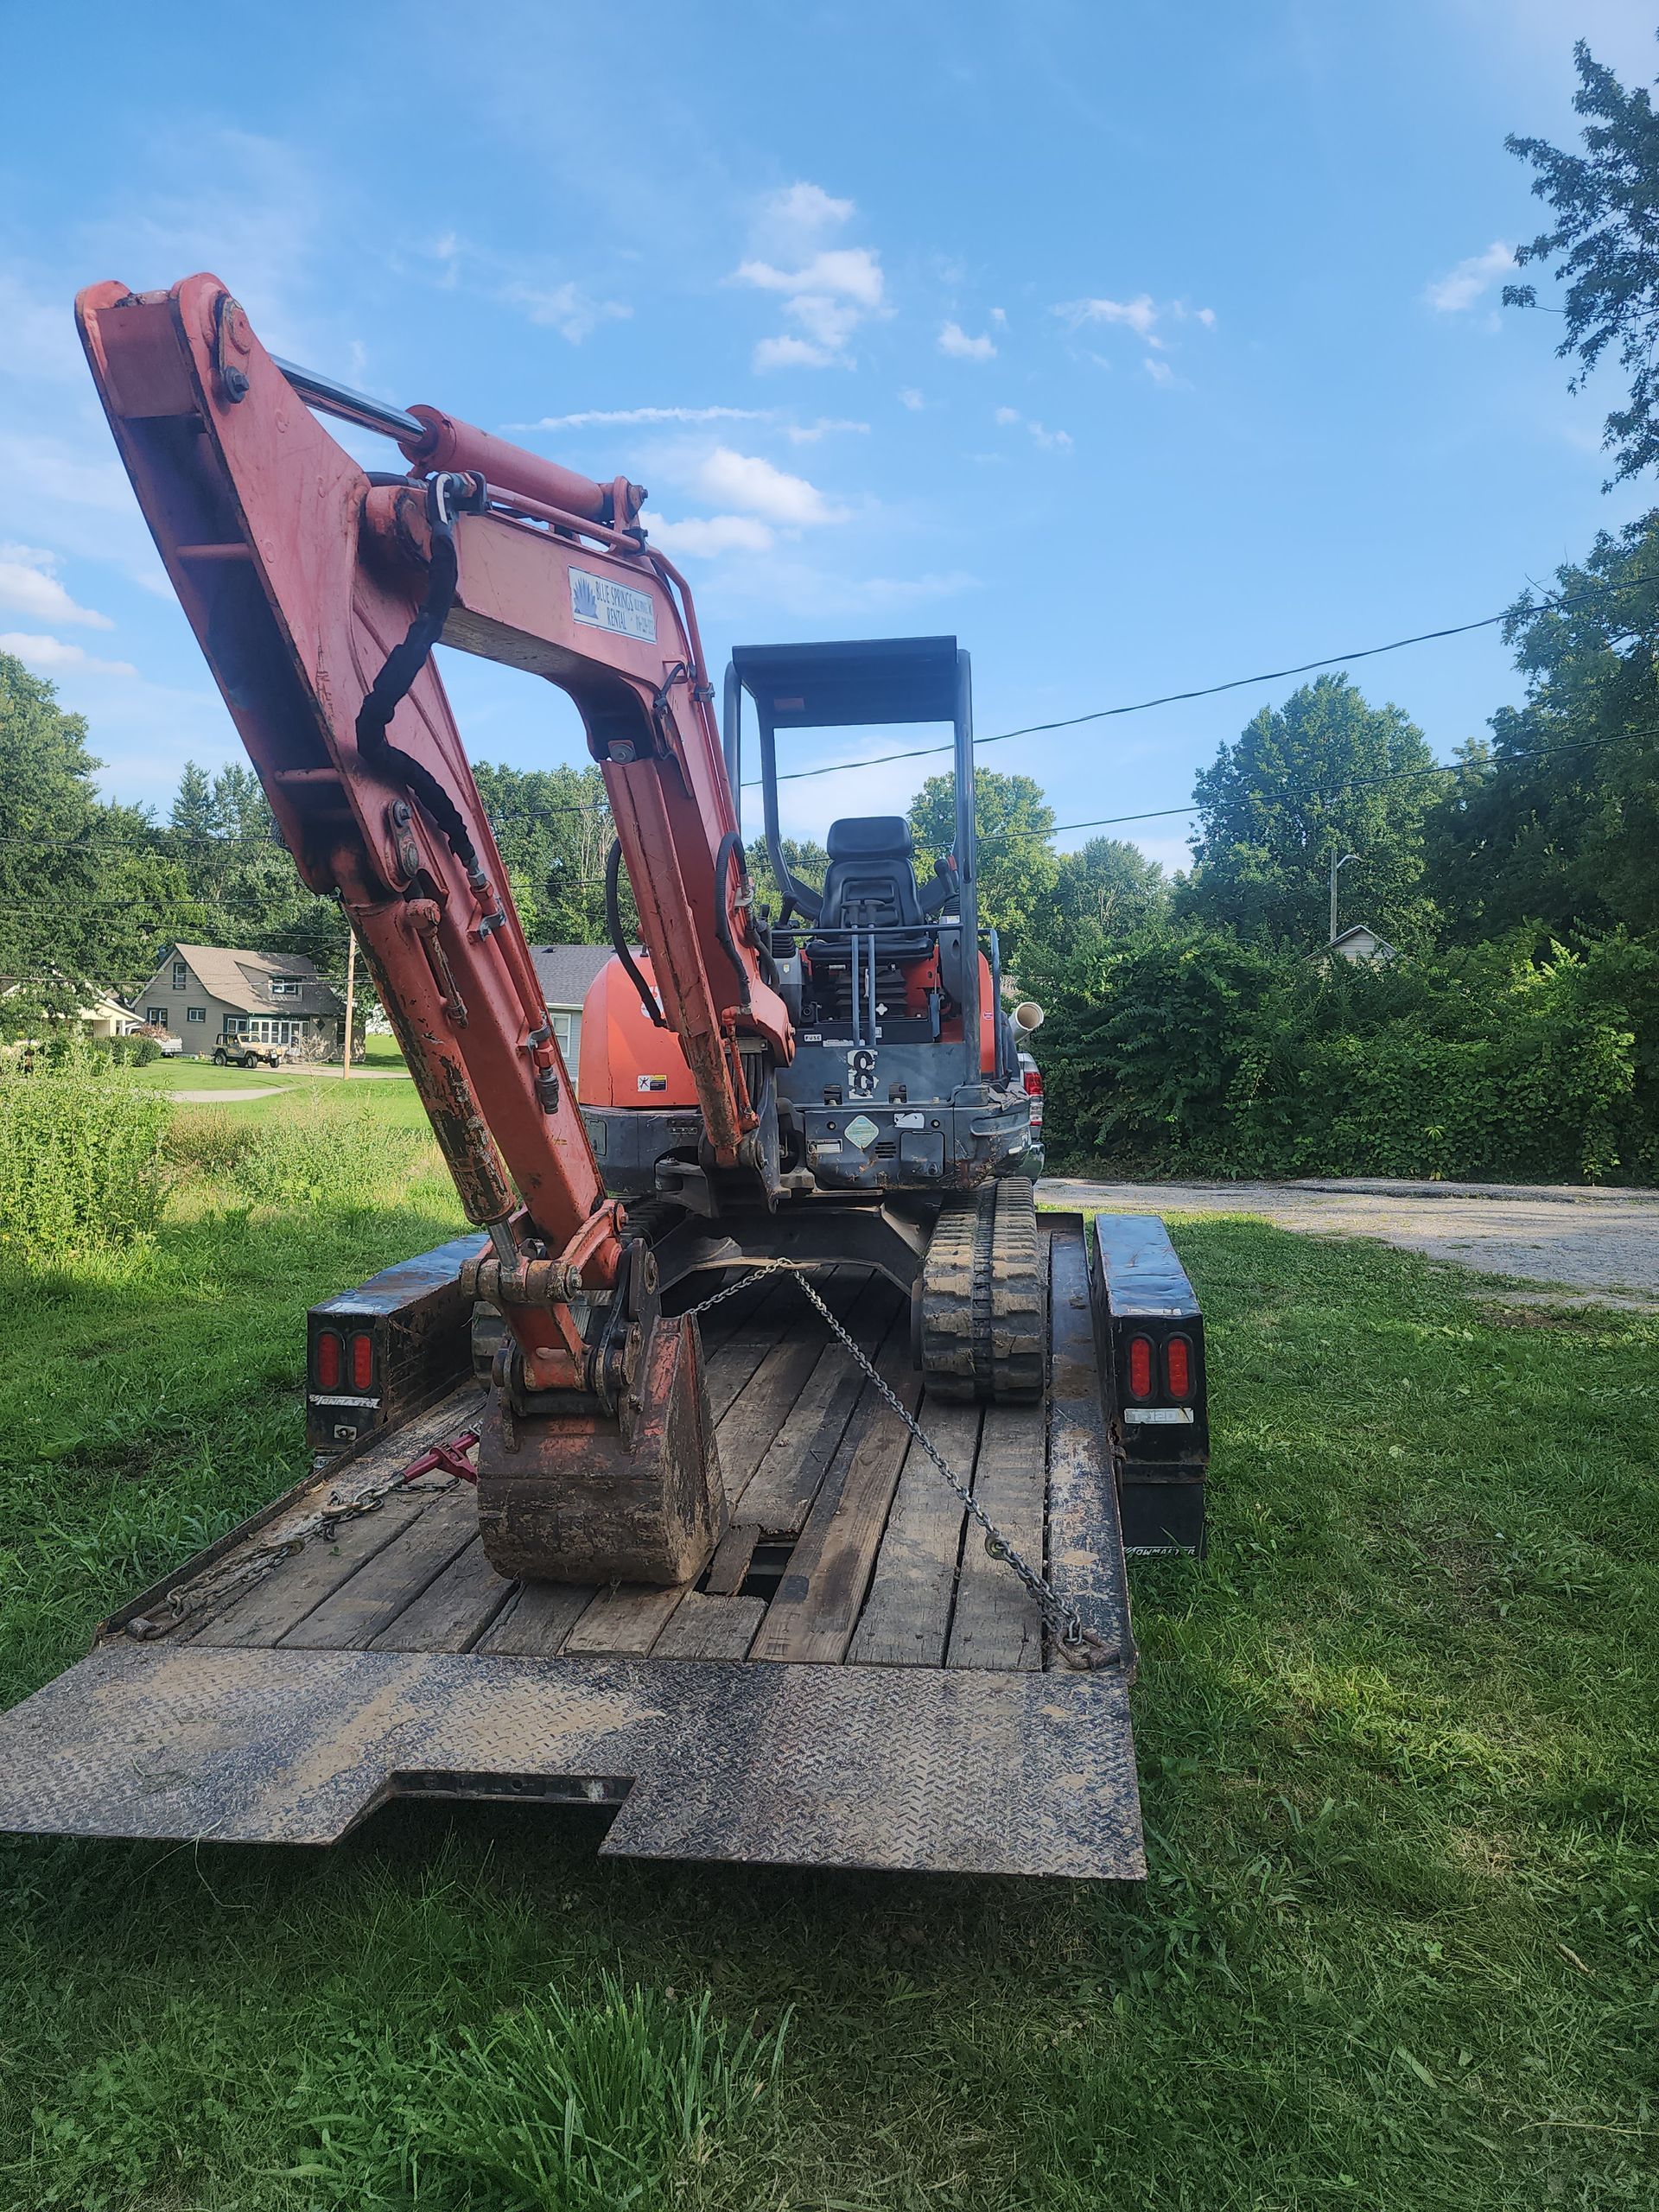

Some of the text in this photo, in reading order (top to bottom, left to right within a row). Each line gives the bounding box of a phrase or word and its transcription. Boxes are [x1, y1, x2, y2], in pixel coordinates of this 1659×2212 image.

[595, 581, 610, 604] BLUE
[611, 586, 634, 612] SPRINGS
[607, 607, 627, 630] RENTAL
[853, 1050, 874, 1097] 8
[308, 1394, 381, 1409] TOWMASTER
